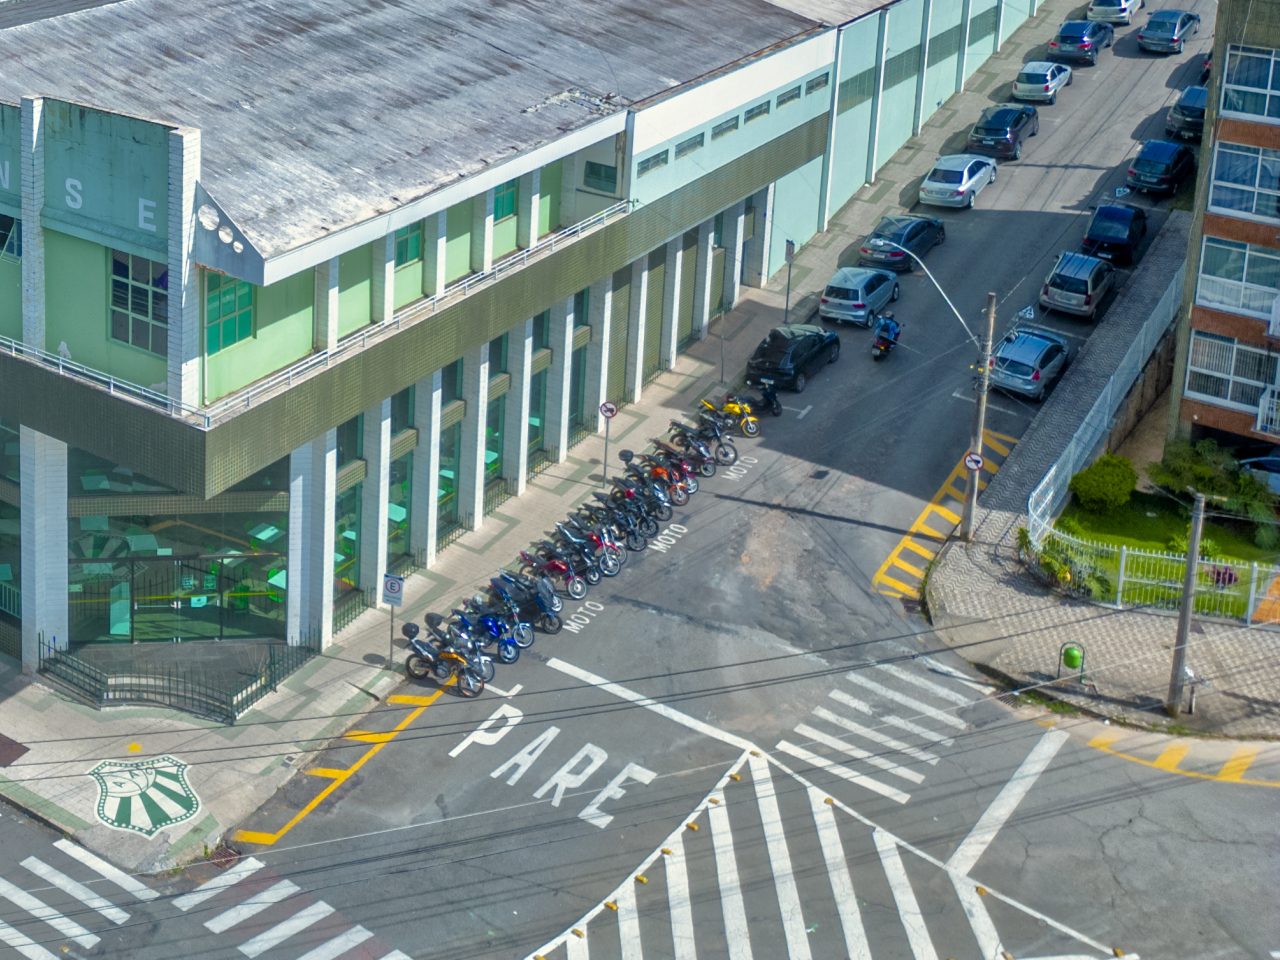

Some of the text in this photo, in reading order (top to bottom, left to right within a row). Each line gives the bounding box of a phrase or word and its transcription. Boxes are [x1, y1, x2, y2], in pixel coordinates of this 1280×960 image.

[720, 455, 759, 482] MOTO
[648, 523, 689, 553] MOTO
[562, 600, 605, 634] MOTO
[448, 703, 658, 829] PARE
